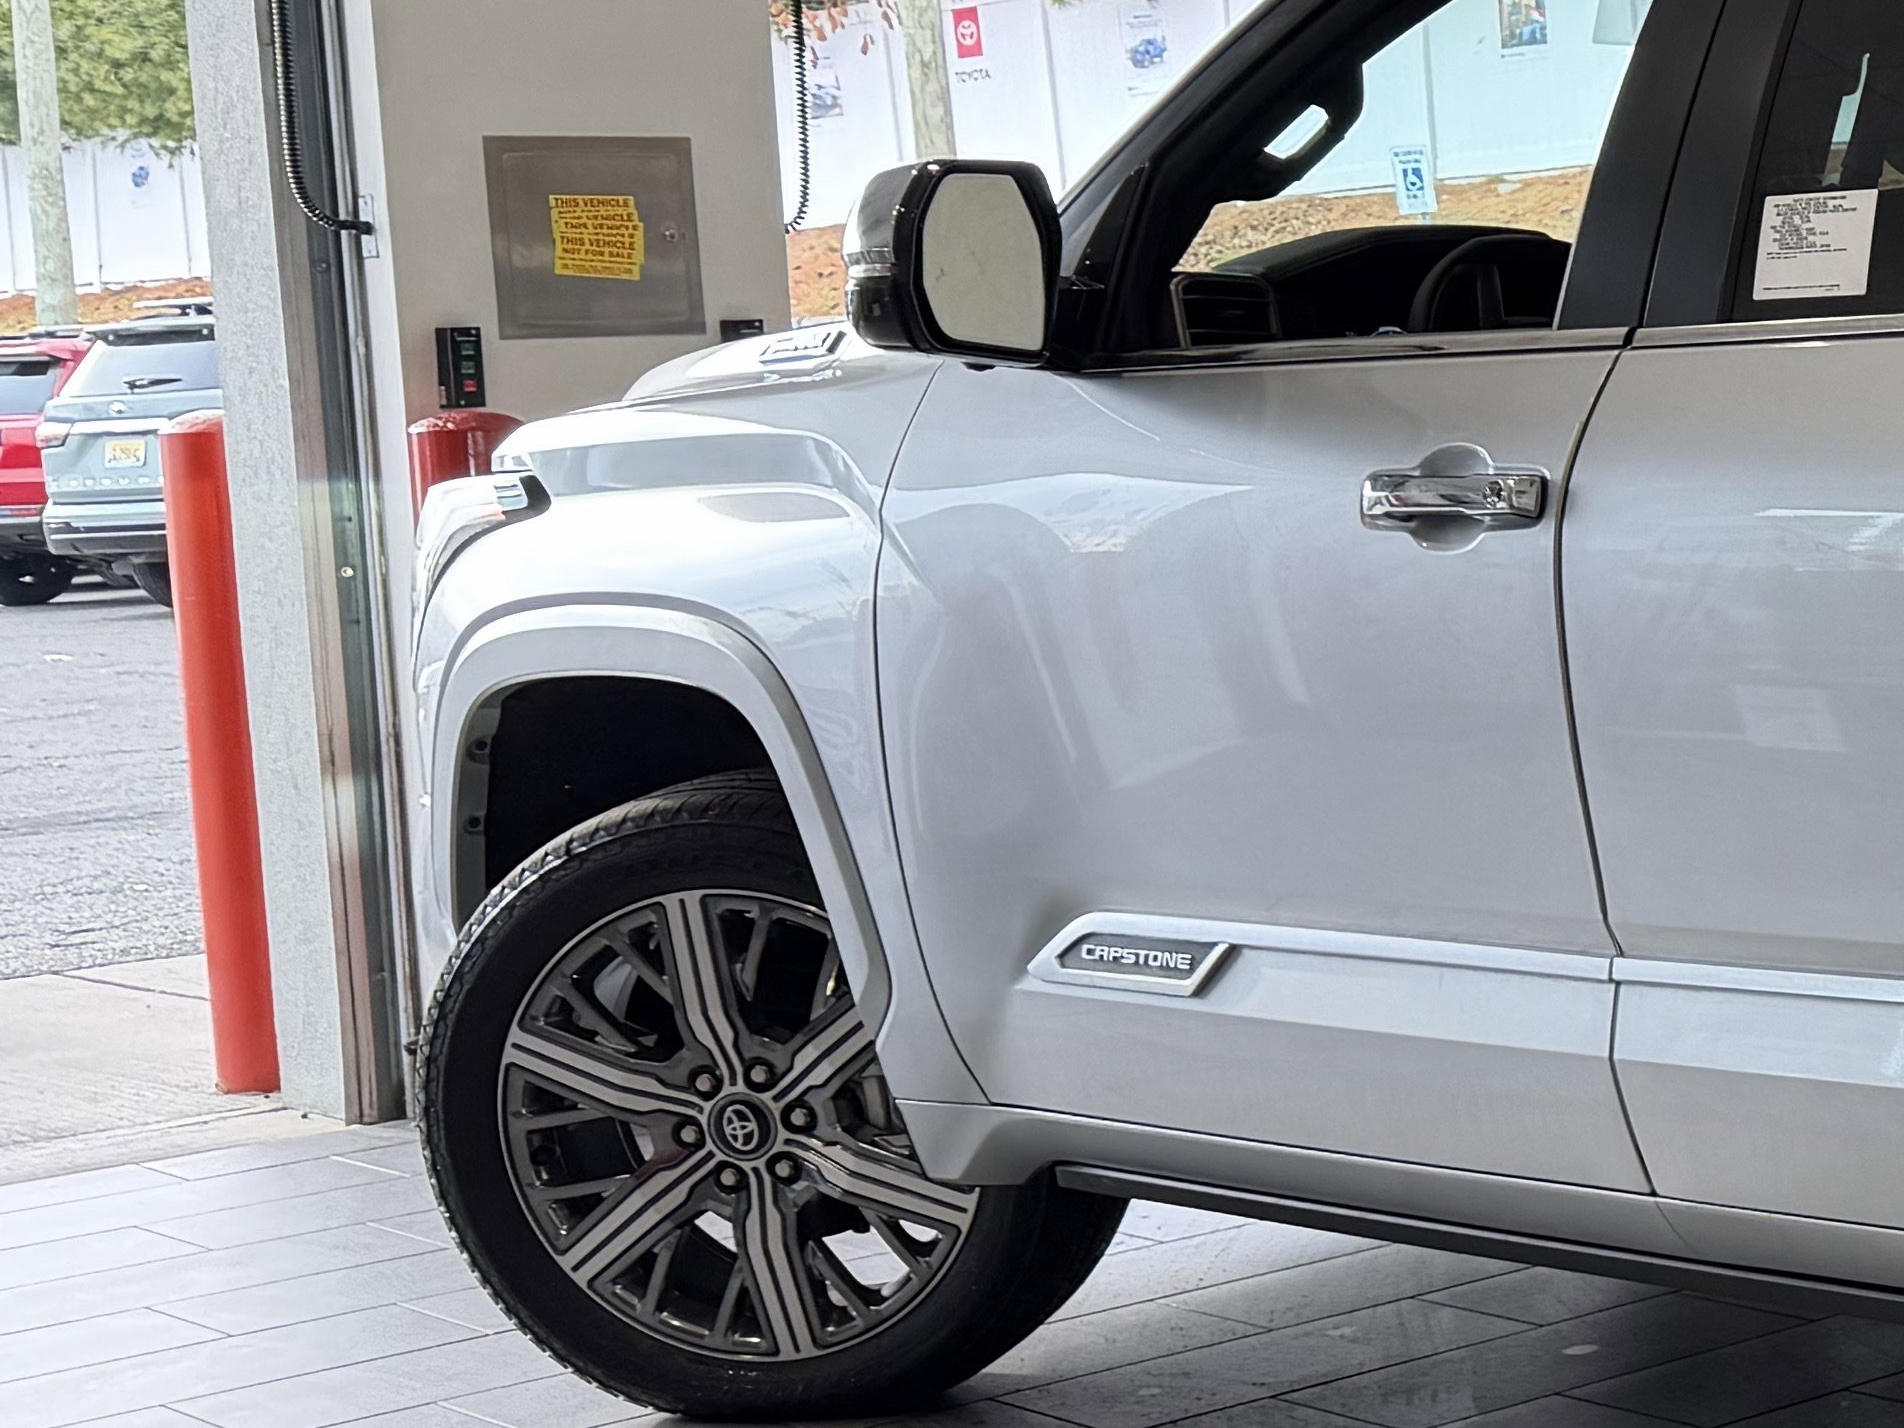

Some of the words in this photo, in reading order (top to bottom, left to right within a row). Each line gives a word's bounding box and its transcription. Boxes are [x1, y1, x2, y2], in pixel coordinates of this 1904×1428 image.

[554, 197, 579, 209] THIS
[582, 198, 630, 209] VEHICLE
[560, 235, 585, 247] THIS
[588, 237, 637, 251] VEHICLE
[585, 249, 605, 258] FOR
[1080, 943, 1193, 970] CAPSTONE
